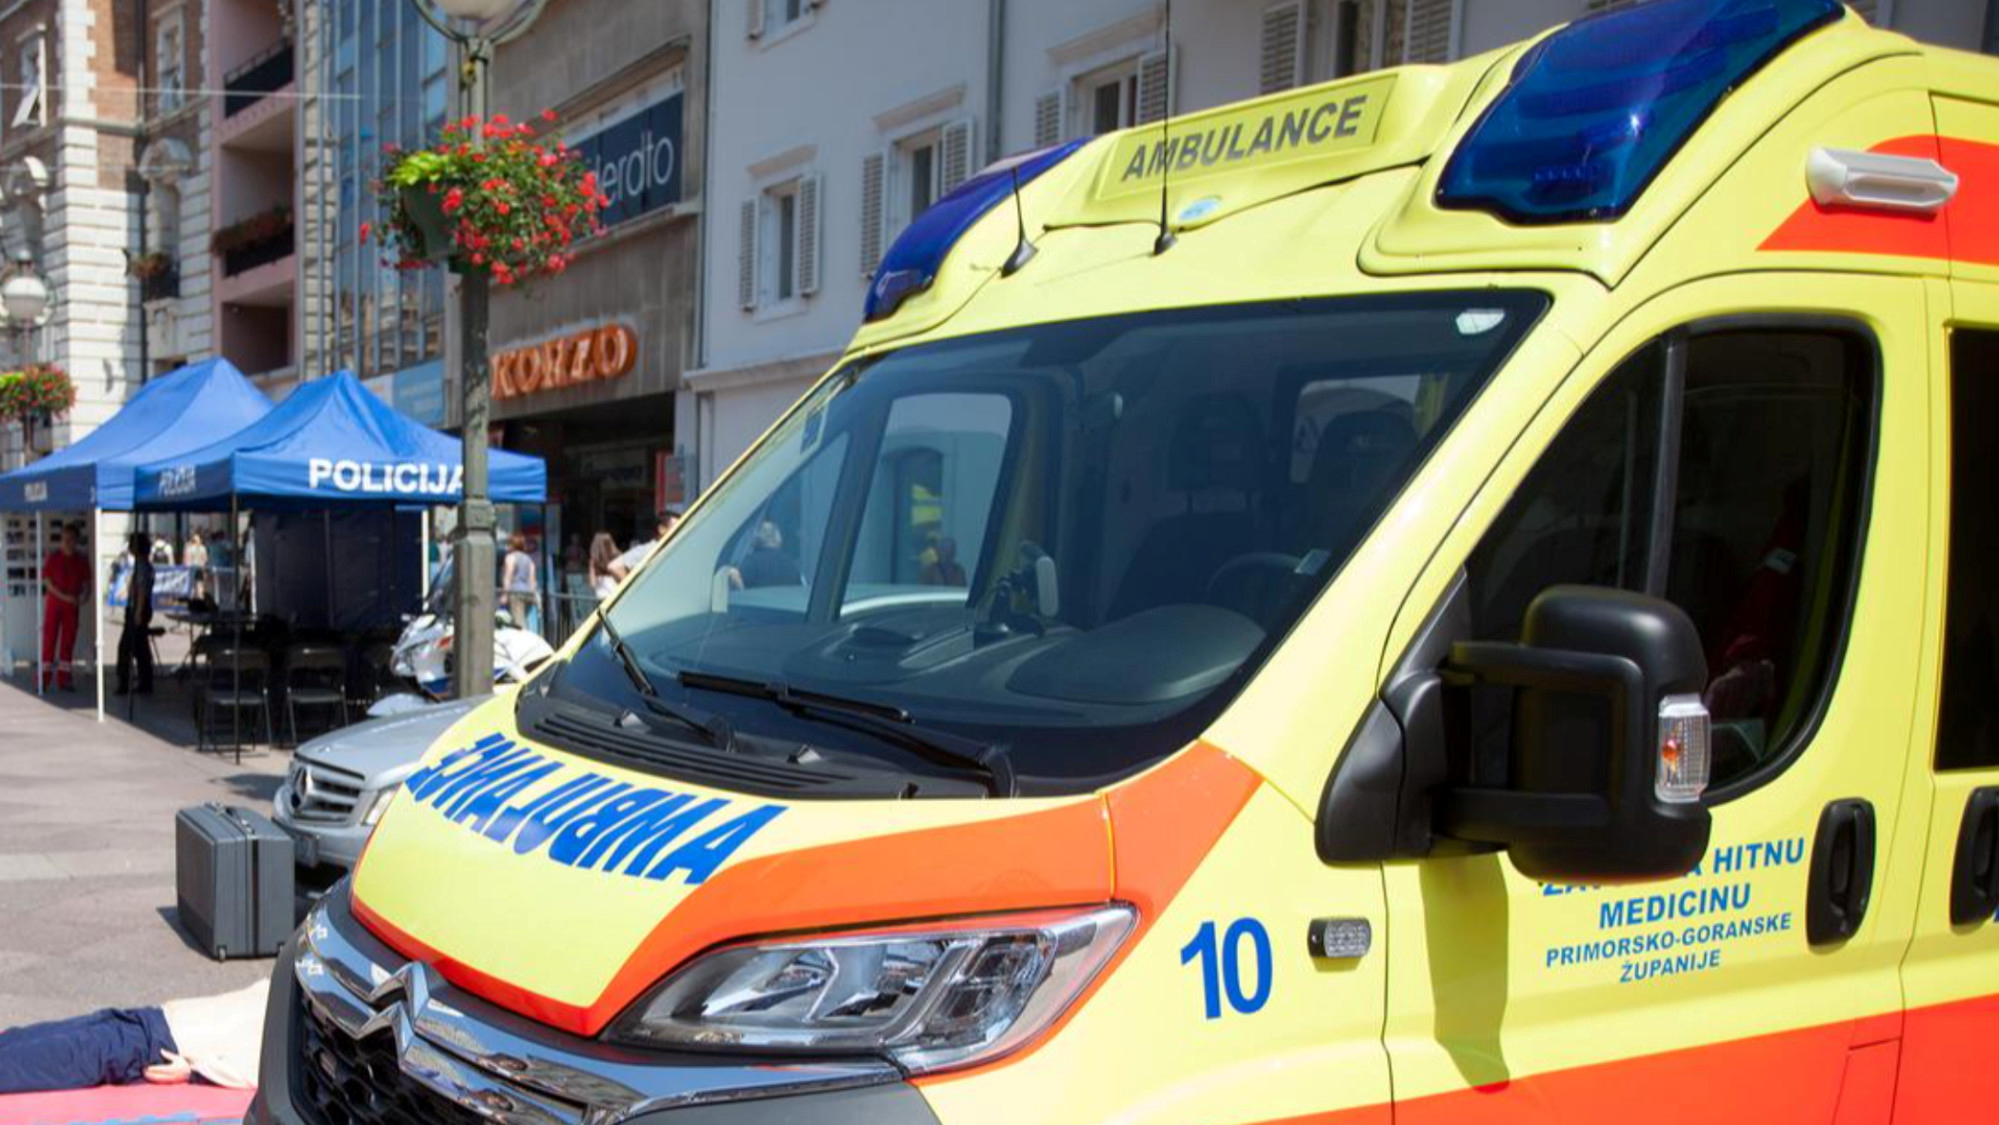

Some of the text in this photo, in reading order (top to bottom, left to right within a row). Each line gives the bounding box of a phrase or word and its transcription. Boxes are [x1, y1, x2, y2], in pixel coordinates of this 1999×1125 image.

[1121, 94, 1369, 182] AMBULANCE
[490, 322, 637, 400] KORZO
[1713, 837, 1804, 874] HITNU
[1599, 883, 1751, 929] MEDICINU
[1546, 912, 1792, 967] PRIMORSKO-GORANSKE
[1620, 949, 1721, 983] ŽUPANIJE
[1180, 917, 1273, 1020] 10
